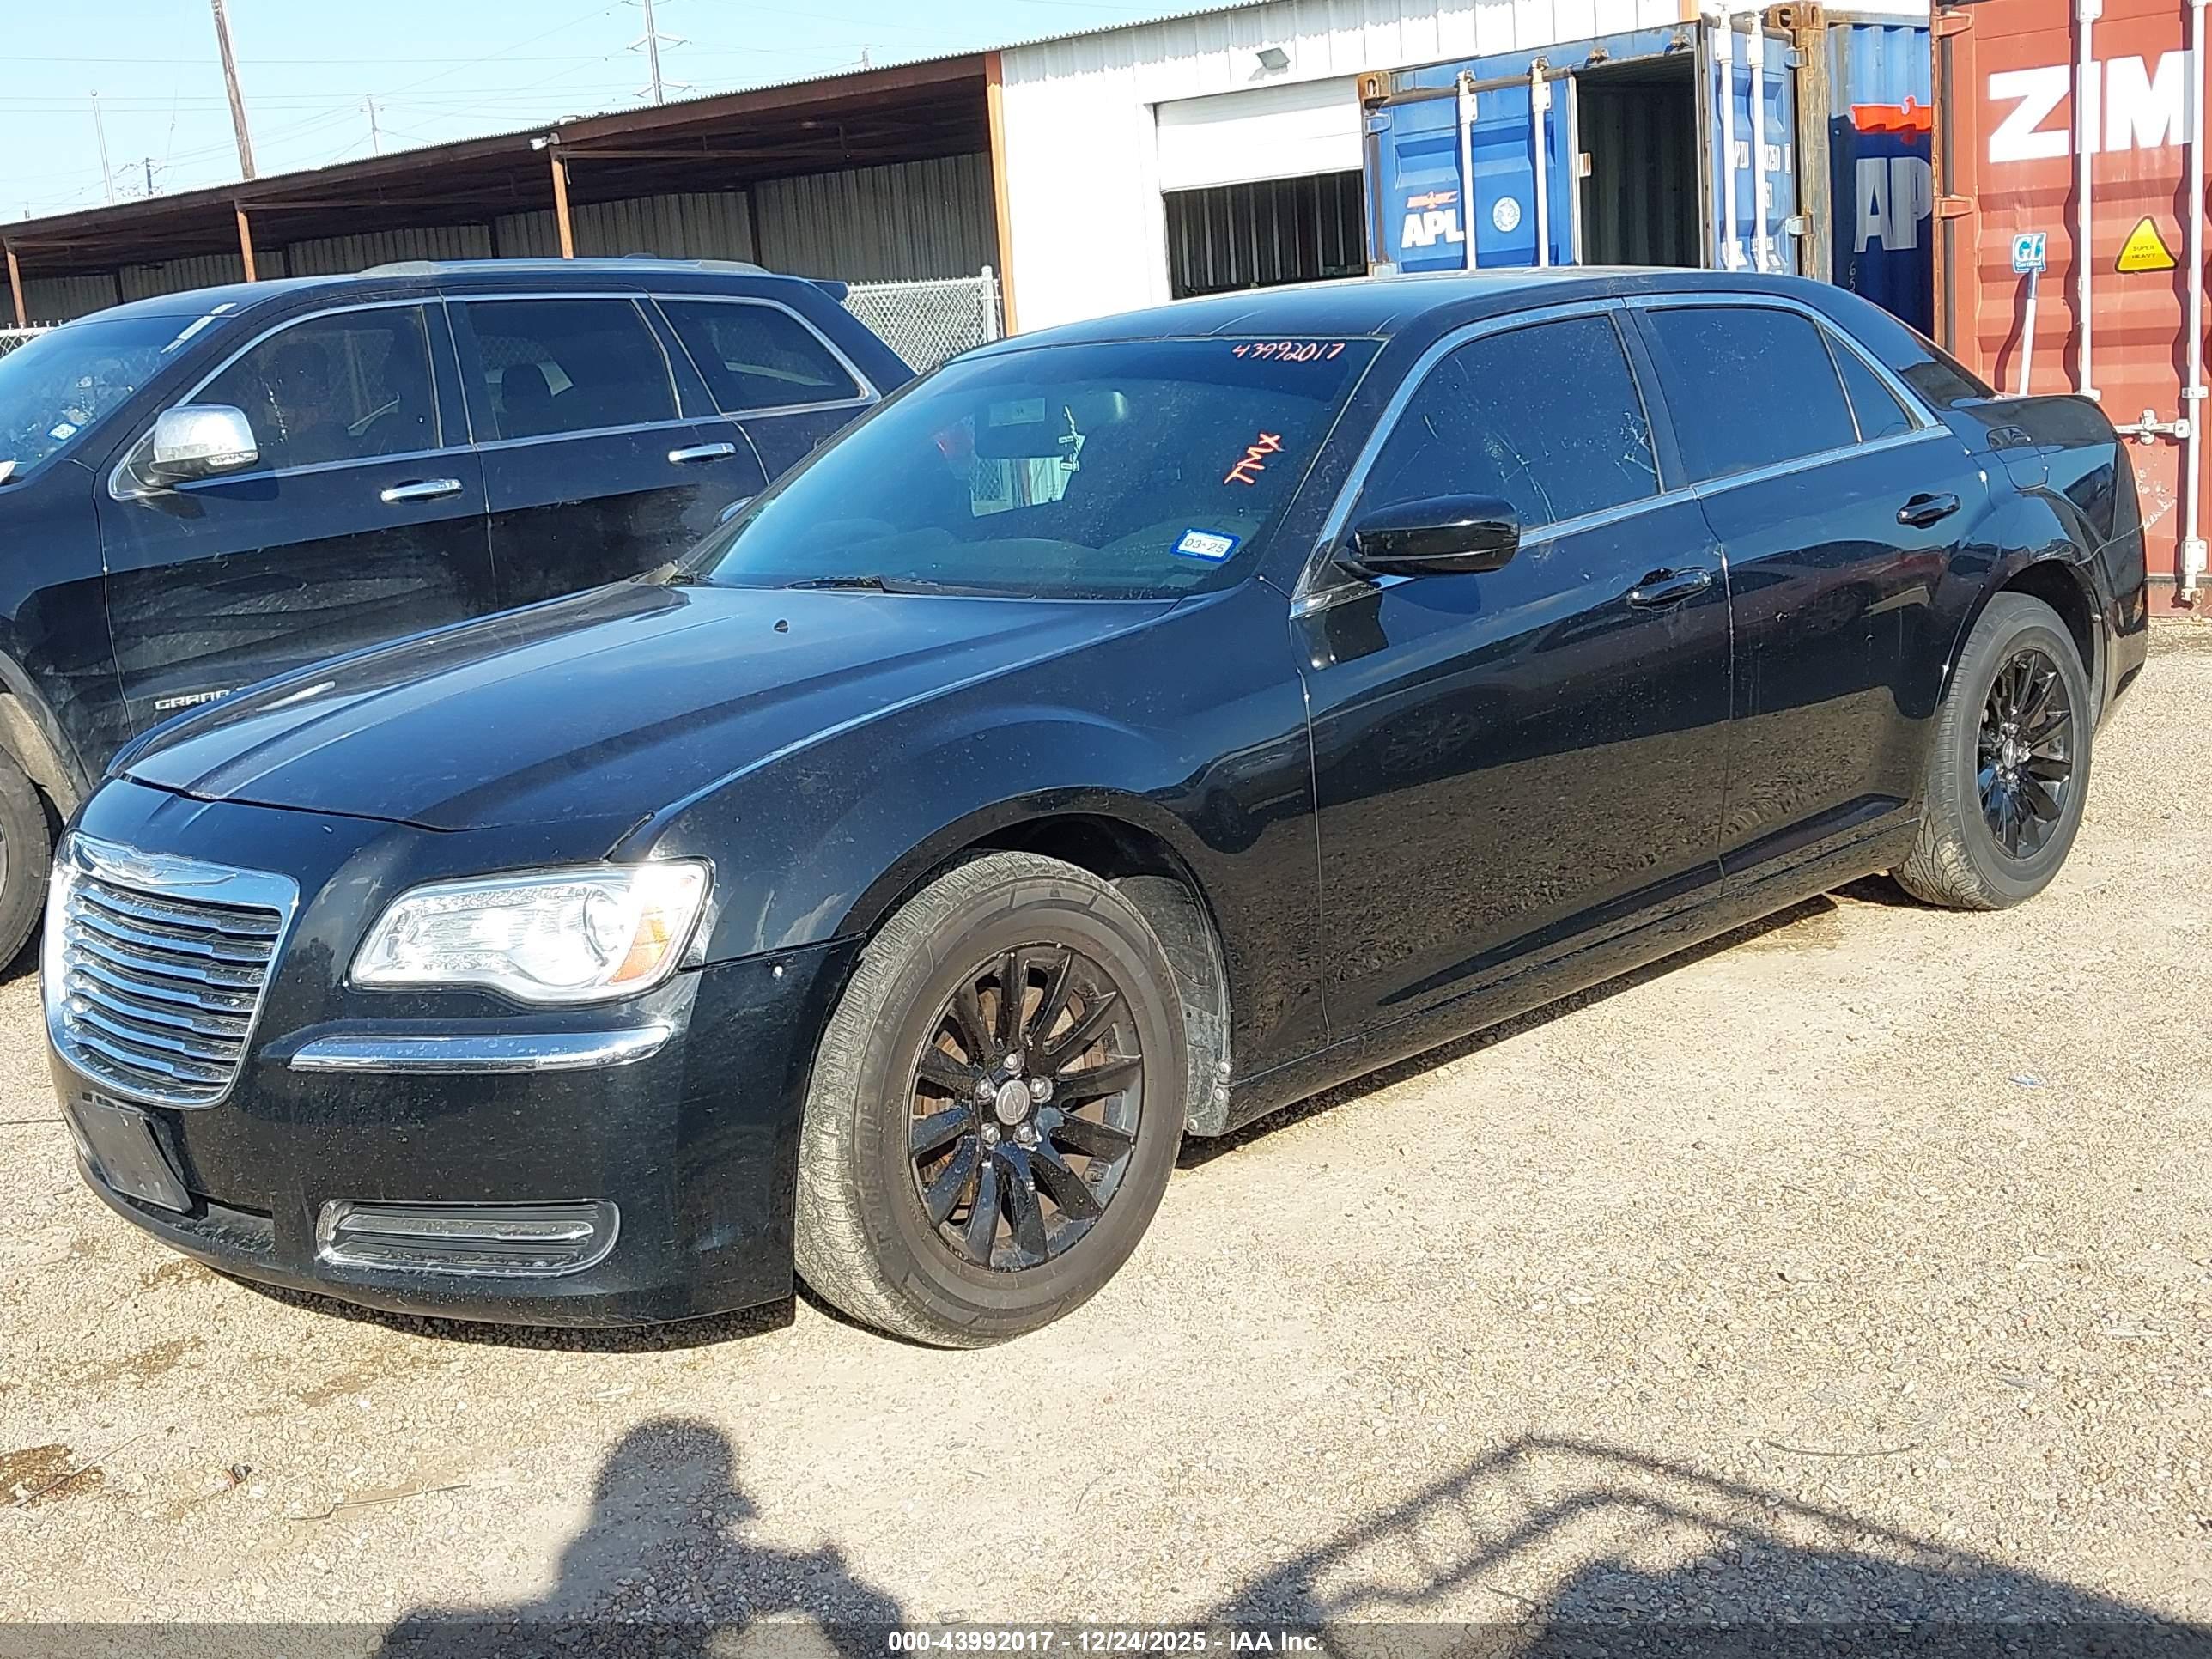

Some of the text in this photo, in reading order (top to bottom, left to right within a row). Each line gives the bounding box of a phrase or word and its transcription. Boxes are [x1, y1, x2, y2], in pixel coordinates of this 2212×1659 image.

[1989, 49, 2193, 163] ZIM
[1401, 209, 1465, 248] APL
[1231, 341, 1346, 362] 43992017
[1223, 432, 1283, 484] TMX
[155, 690, 229, 711] GRAND
